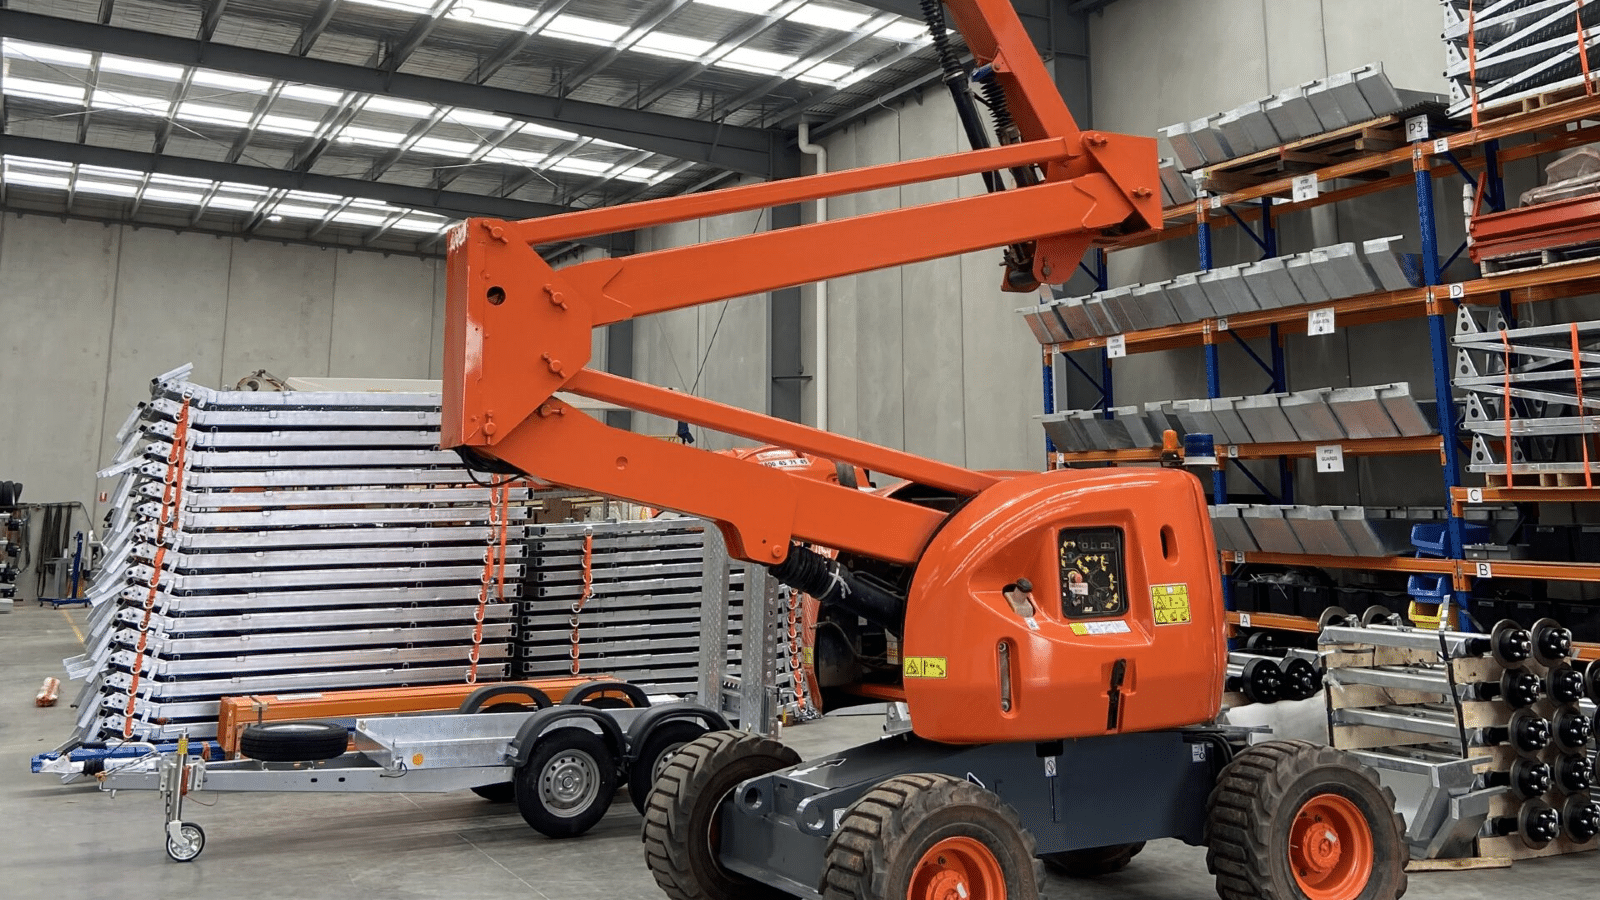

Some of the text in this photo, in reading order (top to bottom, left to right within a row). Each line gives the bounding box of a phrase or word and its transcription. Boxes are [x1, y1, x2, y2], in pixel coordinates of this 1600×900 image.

[1409, 121, 1423, 134] P3
[1436, 139, 1445, 151] E
[1452, 285, 1462, 296] D
[1229, 446, 1237, 456] C
[1470, 489, 1479, 501] C
[1479, 563, 1489, 576] B
[1241, 614, 1249, 625] A
